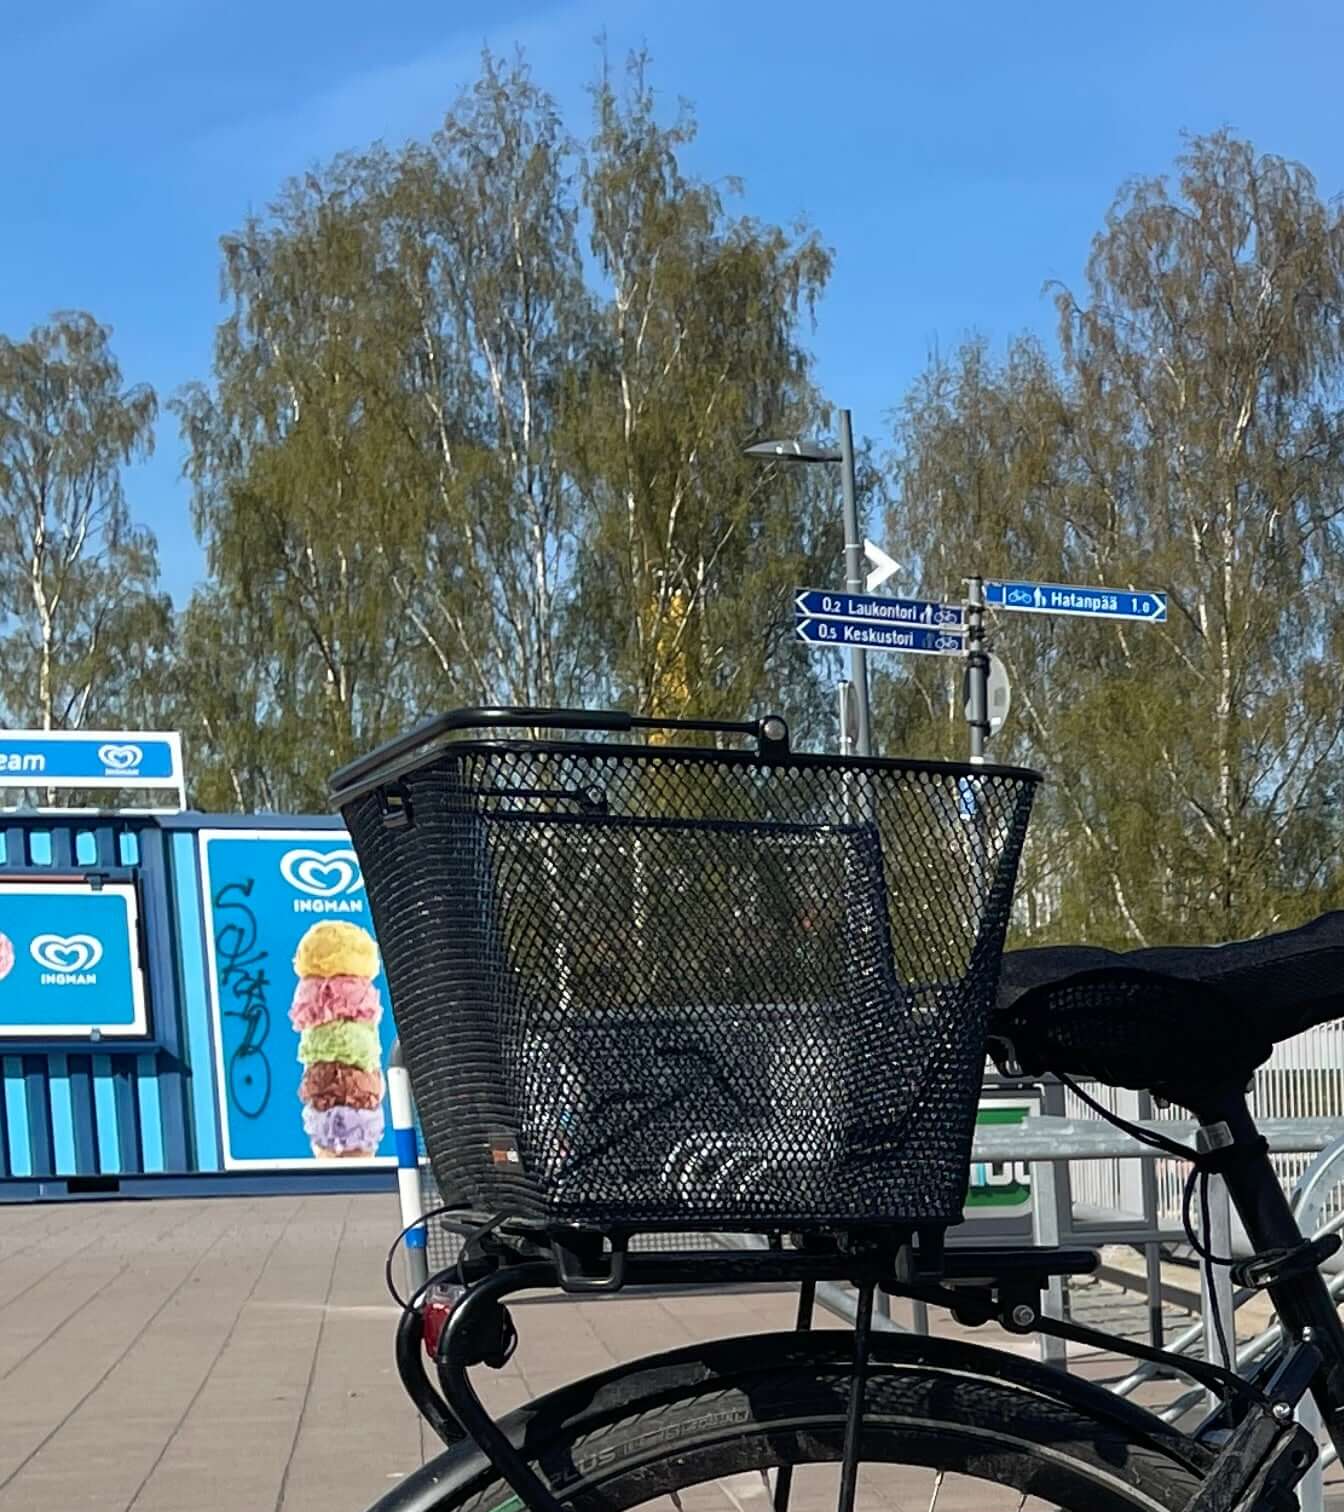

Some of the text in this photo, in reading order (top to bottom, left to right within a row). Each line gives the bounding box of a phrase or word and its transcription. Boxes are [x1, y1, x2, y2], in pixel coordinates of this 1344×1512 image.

[848, 599, 917, 621] Laukontori
[1051, 592, 1118, 612] Hatanpää
[843, 625, 914, 647] Keskustori
[293, 899, 363, 914] INGMAN
[40, 973, 97, 985] INGMAN
